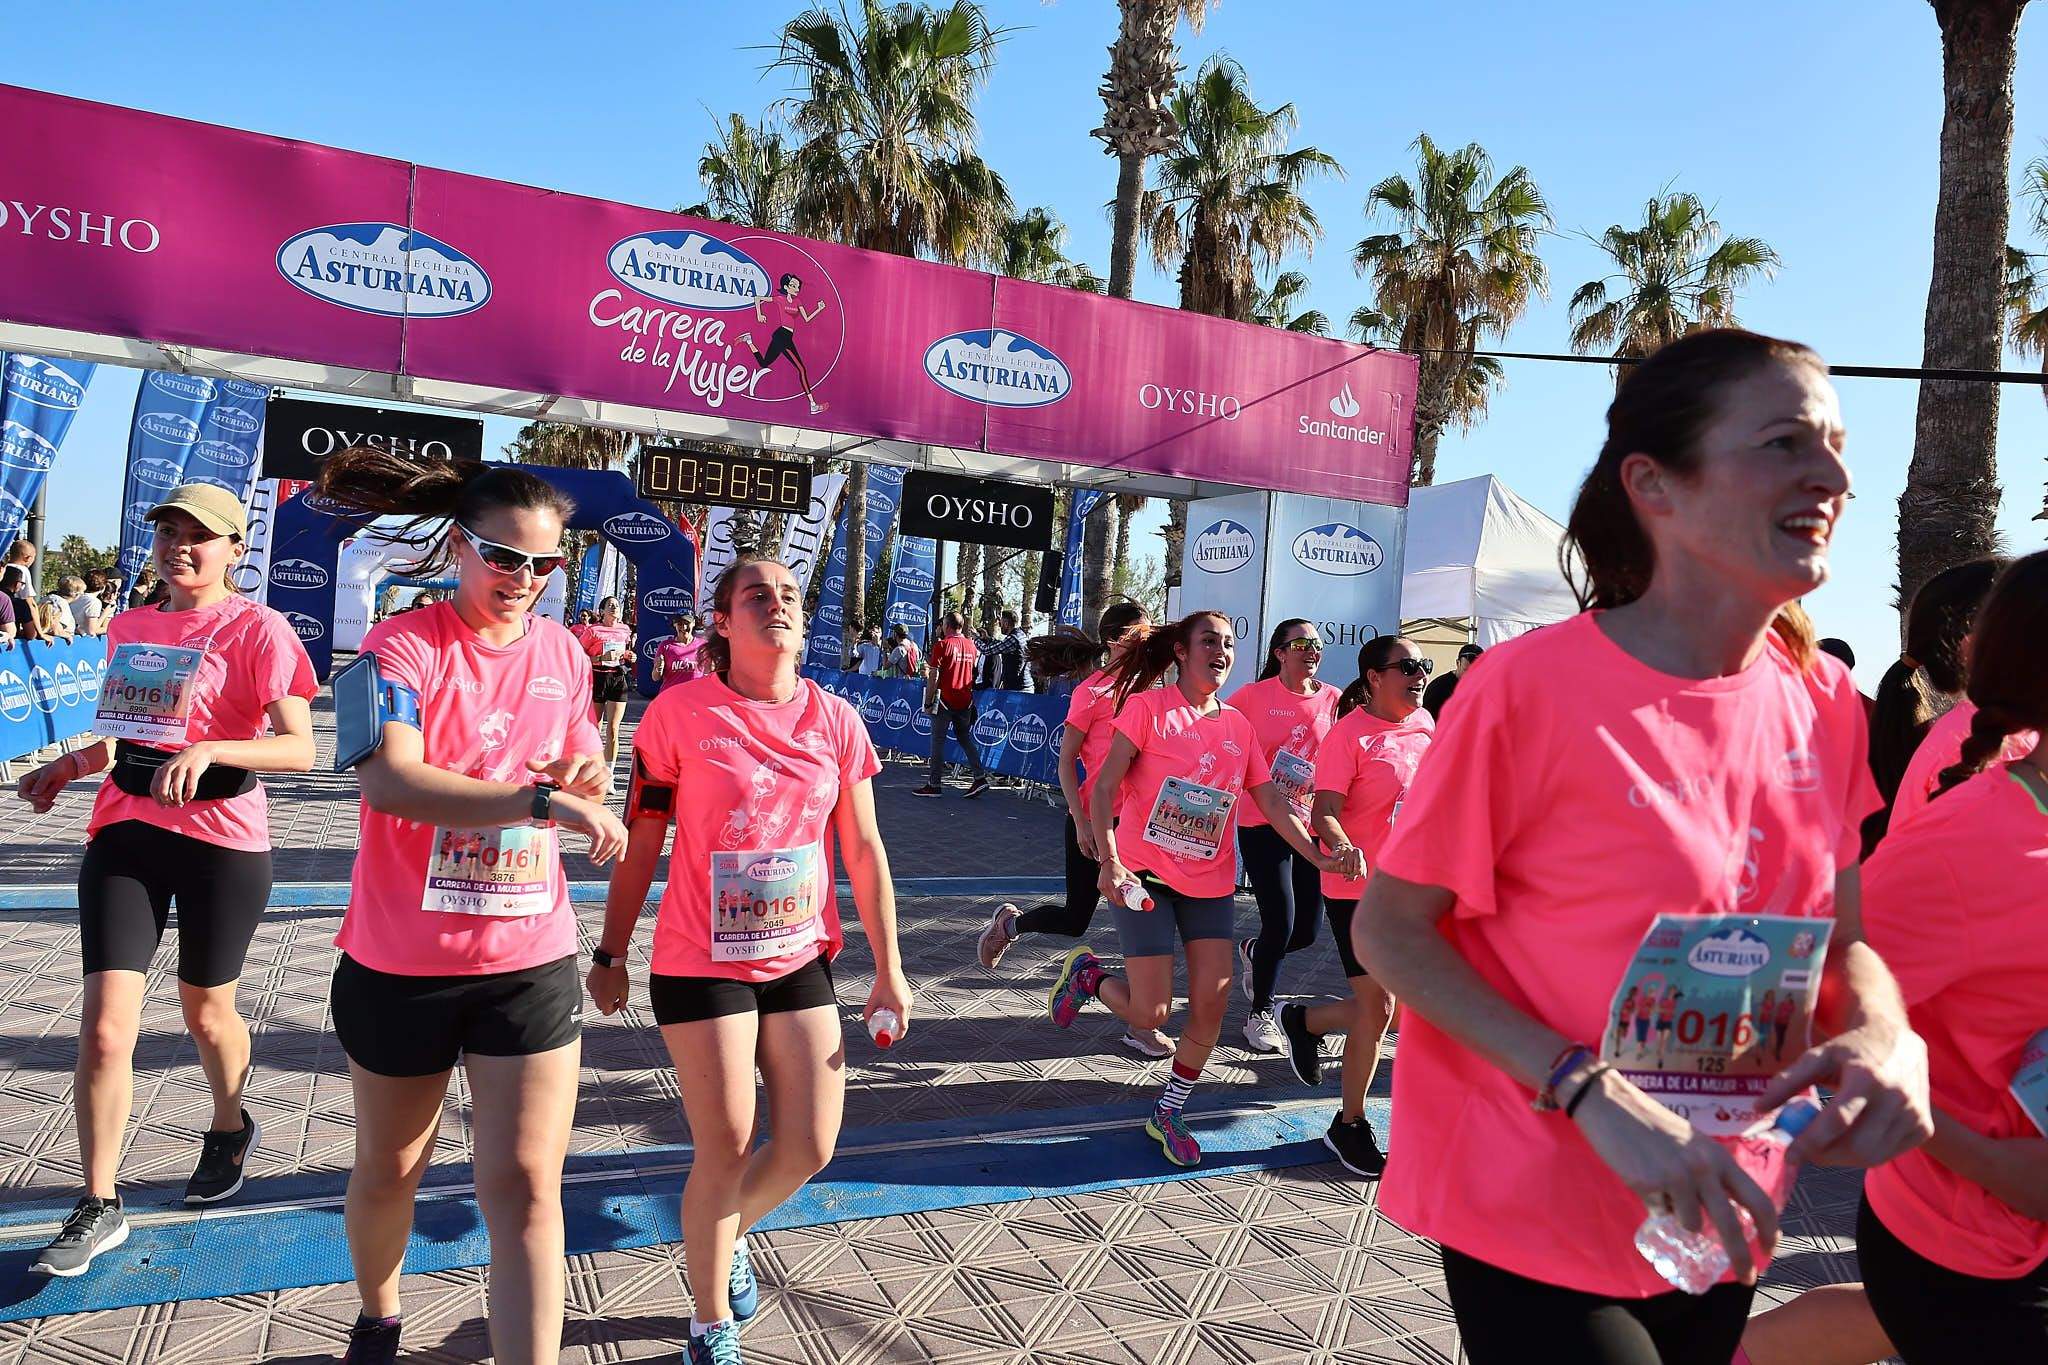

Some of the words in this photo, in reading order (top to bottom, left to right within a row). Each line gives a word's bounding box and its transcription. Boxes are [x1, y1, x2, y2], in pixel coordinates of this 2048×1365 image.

[0, 200, 161, 254] YSHO
[329, 247, 397, 265] CENTRAL
[647, 249, 699, 266] CENTRAL
[703, 261, 755, 276] LECHERA
[619, 247, 758, 298] ASTURIANA
[588, 289, 725, 347] Carrera
[934, 348, 1060, 394] ASTURIANA
[959, 350, 1007, 364] CENTRAL
[1010, 356, 1057, 372] LECHERA
[620, 336, 647, 364] de
[651, 338, 671, 368] la
[664, 342, 773, 408] Mujer
[1138, 383, 1241, 422] OYSHO
[209, 409, 255, 431] ASTURIANA
[1298, 415, 1386, 446] Santander
[0, 442, 50, 468] RIANA
[196, 444, 245, 465] ASTURIANA
[651, 455, 799, 505] 00:38:56
[926, 493, 1034, 528] OYSHO
[608, 521, 667, 536] ASTURIANA
[1196, 542, 1250, 562] ASTURIANA
[1298, 539, 1376, 567] ASTURIANA
[271, 568, 325, 584] ASTURIANA
[646, 596, 692, 608] ASTURIANA
[124, 684, 162, 703] 016
[975, 721, 1005, 739] ASTURIANA
[1010, 727, 1044, 744] ASTURIANA
[1178, 813, 1205, 829] 016
[481, 847, 530, 869] 016
[489, 872, 515, 883] 3876
[750, 866, 796, 878] ASTURIANA
[435, 879, 472, 890] CARRERA
[441, 894, 487, 908] OYSHO
[752, 896, 797, 918] 016
[719, 932, 749, 941] CARRERA
[751, 932, 761, 940] DE
[761, 931, 770, 939] LA
[770, 927, 792, 937] MUJER
[763, 919, 784, 929] 2049
[726, 944, 765, 956] OYSHO
[1677, 1009, 1753, 1047] 016
[1696, 1055, 1726, 1073] 125
[1667, 1073, 1682, 1090] DE
[1684, 1074, 1698, 1090] LA
